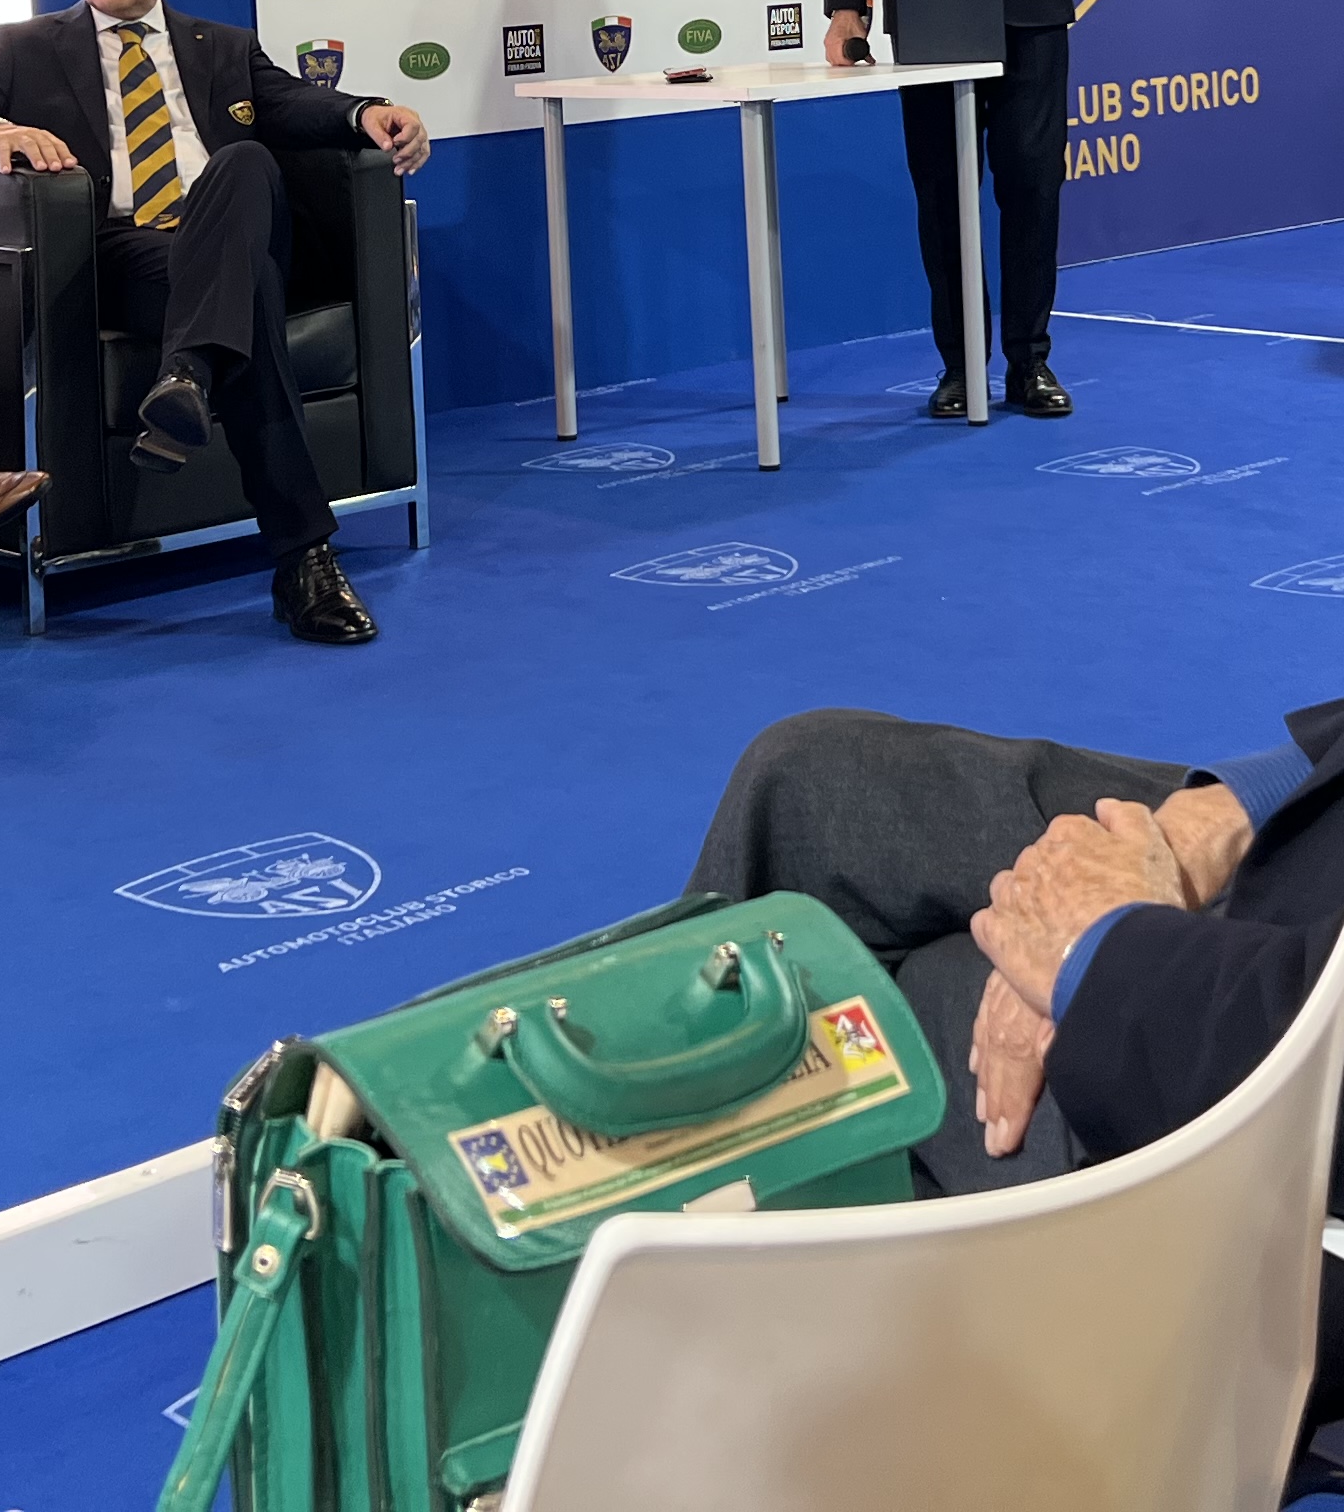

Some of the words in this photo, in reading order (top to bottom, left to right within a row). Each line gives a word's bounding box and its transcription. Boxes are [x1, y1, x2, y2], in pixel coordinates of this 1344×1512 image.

[770, 7, 795, 24] AUTO
[507, 29, 535, 47] AUTO
[1131, 66, 1260, 119] STORICO
[217, 900, 426, 975] AUTOMOTOCLUB
[425, 866, 531, 903] STORICO
